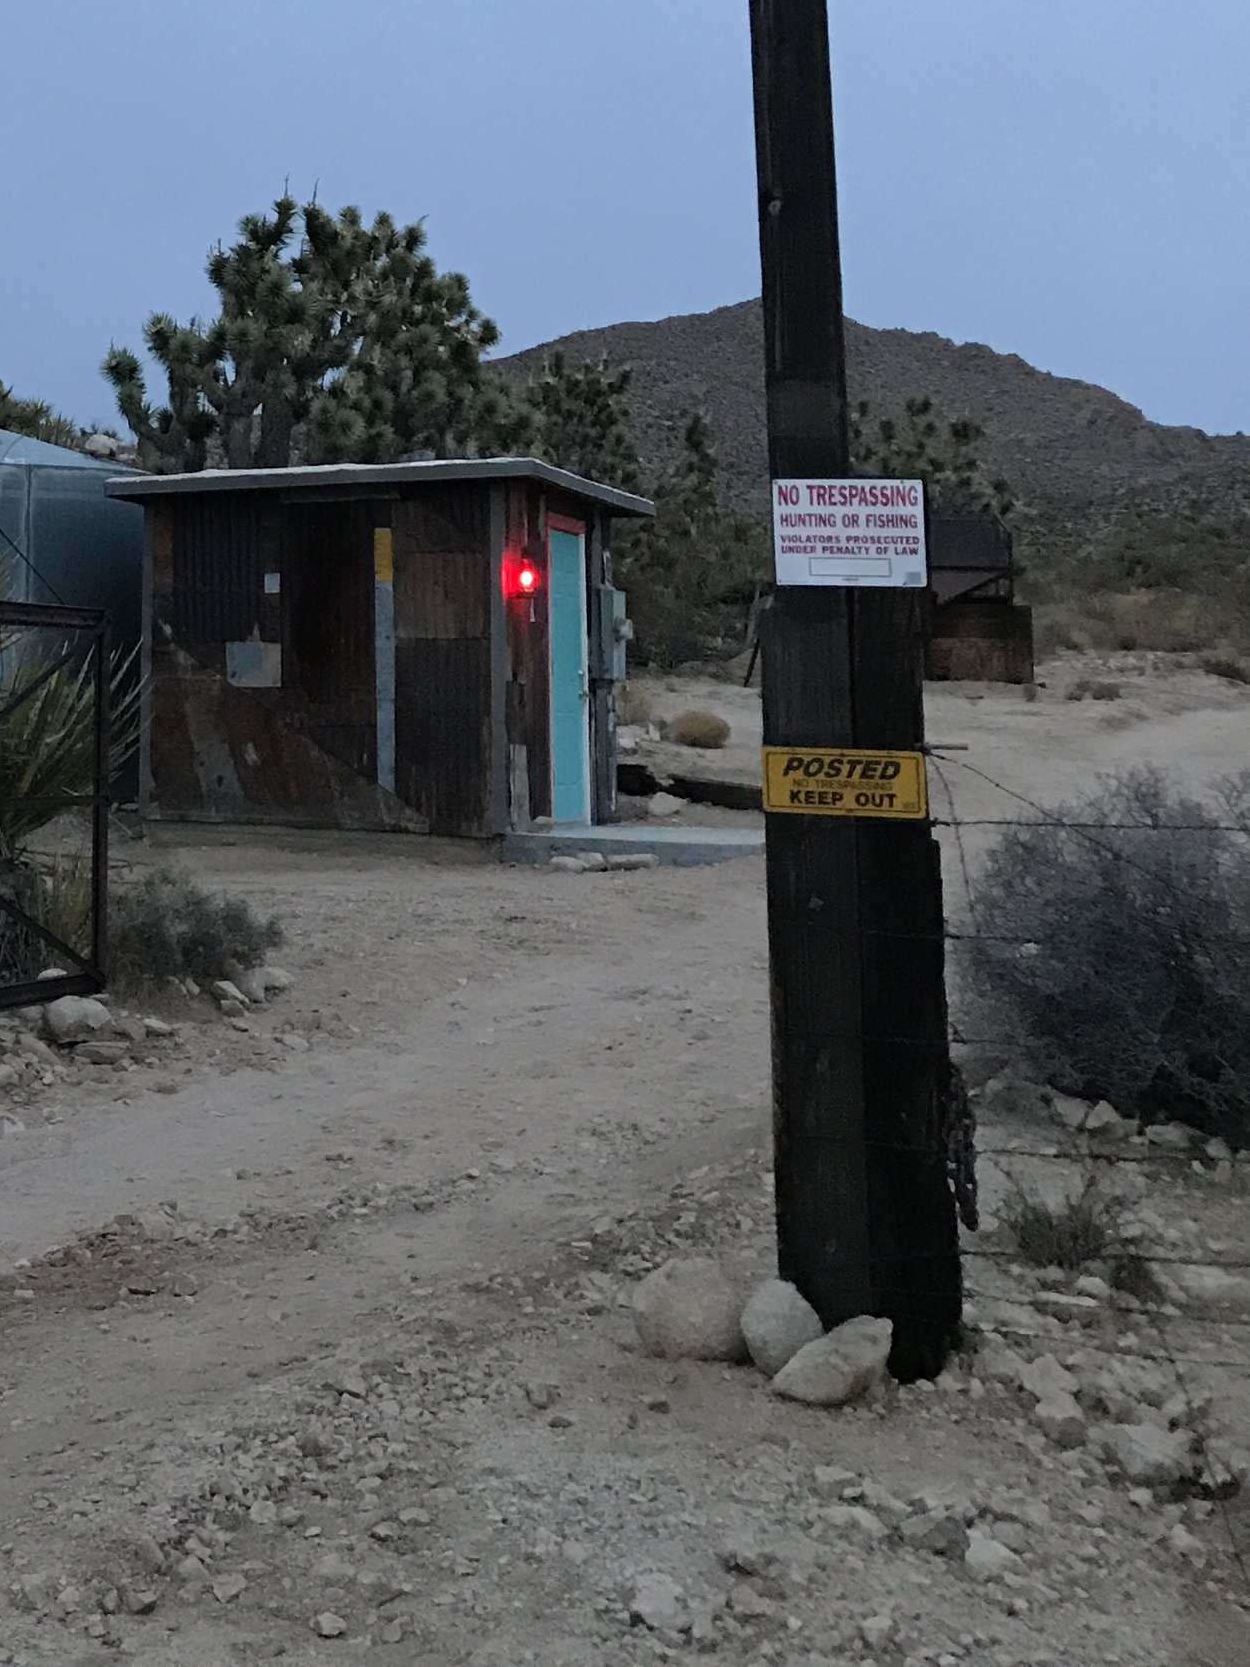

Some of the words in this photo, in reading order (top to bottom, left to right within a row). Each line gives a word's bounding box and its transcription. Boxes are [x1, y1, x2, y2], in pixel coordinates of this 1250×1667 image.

[777, 484, 800, 506] NO
[806, 484, 918, 507] TRESPASSING
[780, 513, 837, 528] HUNTING
[842, 513, 860, 528] OR
[865, 514, 918, 529] FISHING
[780, 534, 841, 544] VIOLATORS
[846, 535, 920, 545] PROSECUTED
[781, 545, 817, 554] UNDER
[822, 546, 870, 555] PENALTY
[875, 546, 890, 555] OF
[894, 547, 919, 556] LAW
[782, 756, 901, 781] POSTED
[792, 778, 810, 788] NO
[815, 779, 893, 791] TRESPASSING
[789, 790, 845, 806] KEEP
[855, 792, 899, 809] OUT
